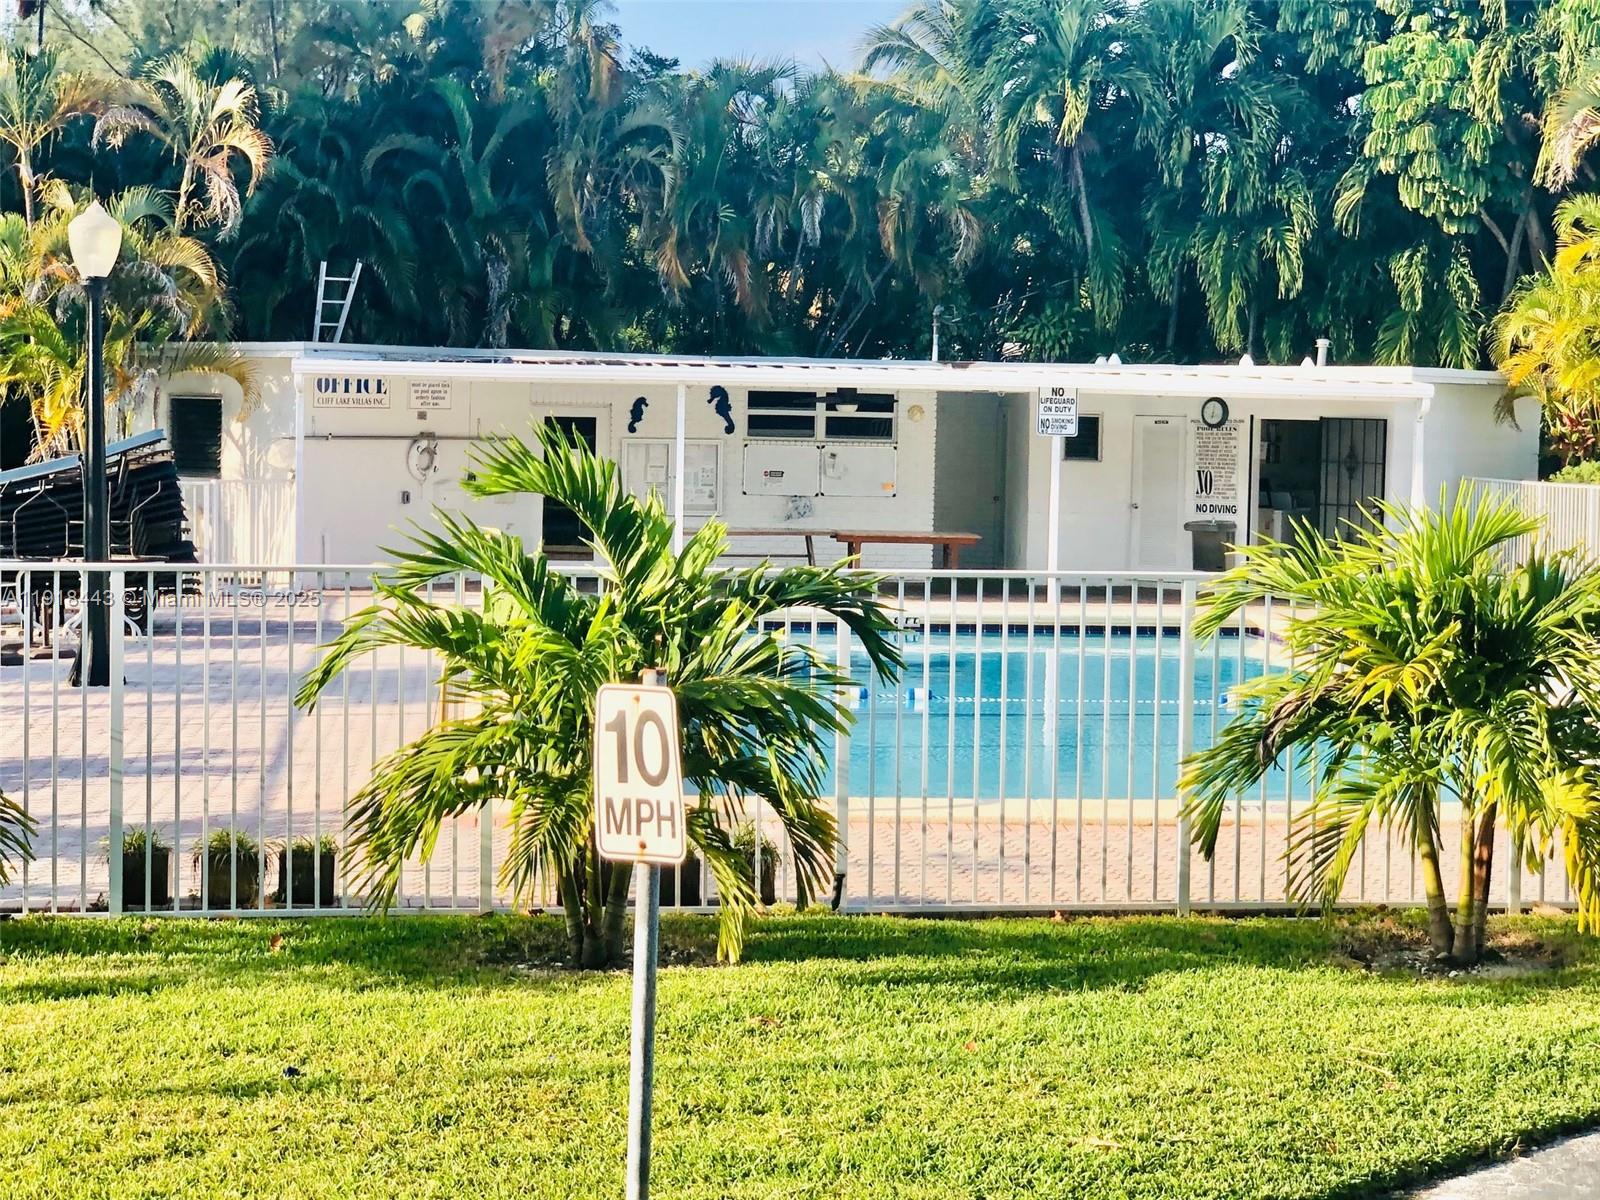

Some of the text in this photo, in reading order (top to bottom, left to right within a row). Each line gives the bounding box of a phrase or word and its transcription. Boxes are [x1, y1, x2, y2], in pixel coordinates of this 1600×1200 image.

[316, 377, 388, 395] OFFICE
[1051, 387, 1065, 397] NO
[317, 396, 335, 405] CLIFF
[336, 396, 350, 405] LAKE
[351, 397, 372, 405] VILLAS
[1040, 397, 1076, 405] LIFEGUARD
[1040, 418, 1051, 429] NO
[1195, 469, 1213, 496] NO
[1195, 503, 1237, 514] NO DIVING
[605, 709, 670, 787] 10
[605, 797, 676, 839] MPH
